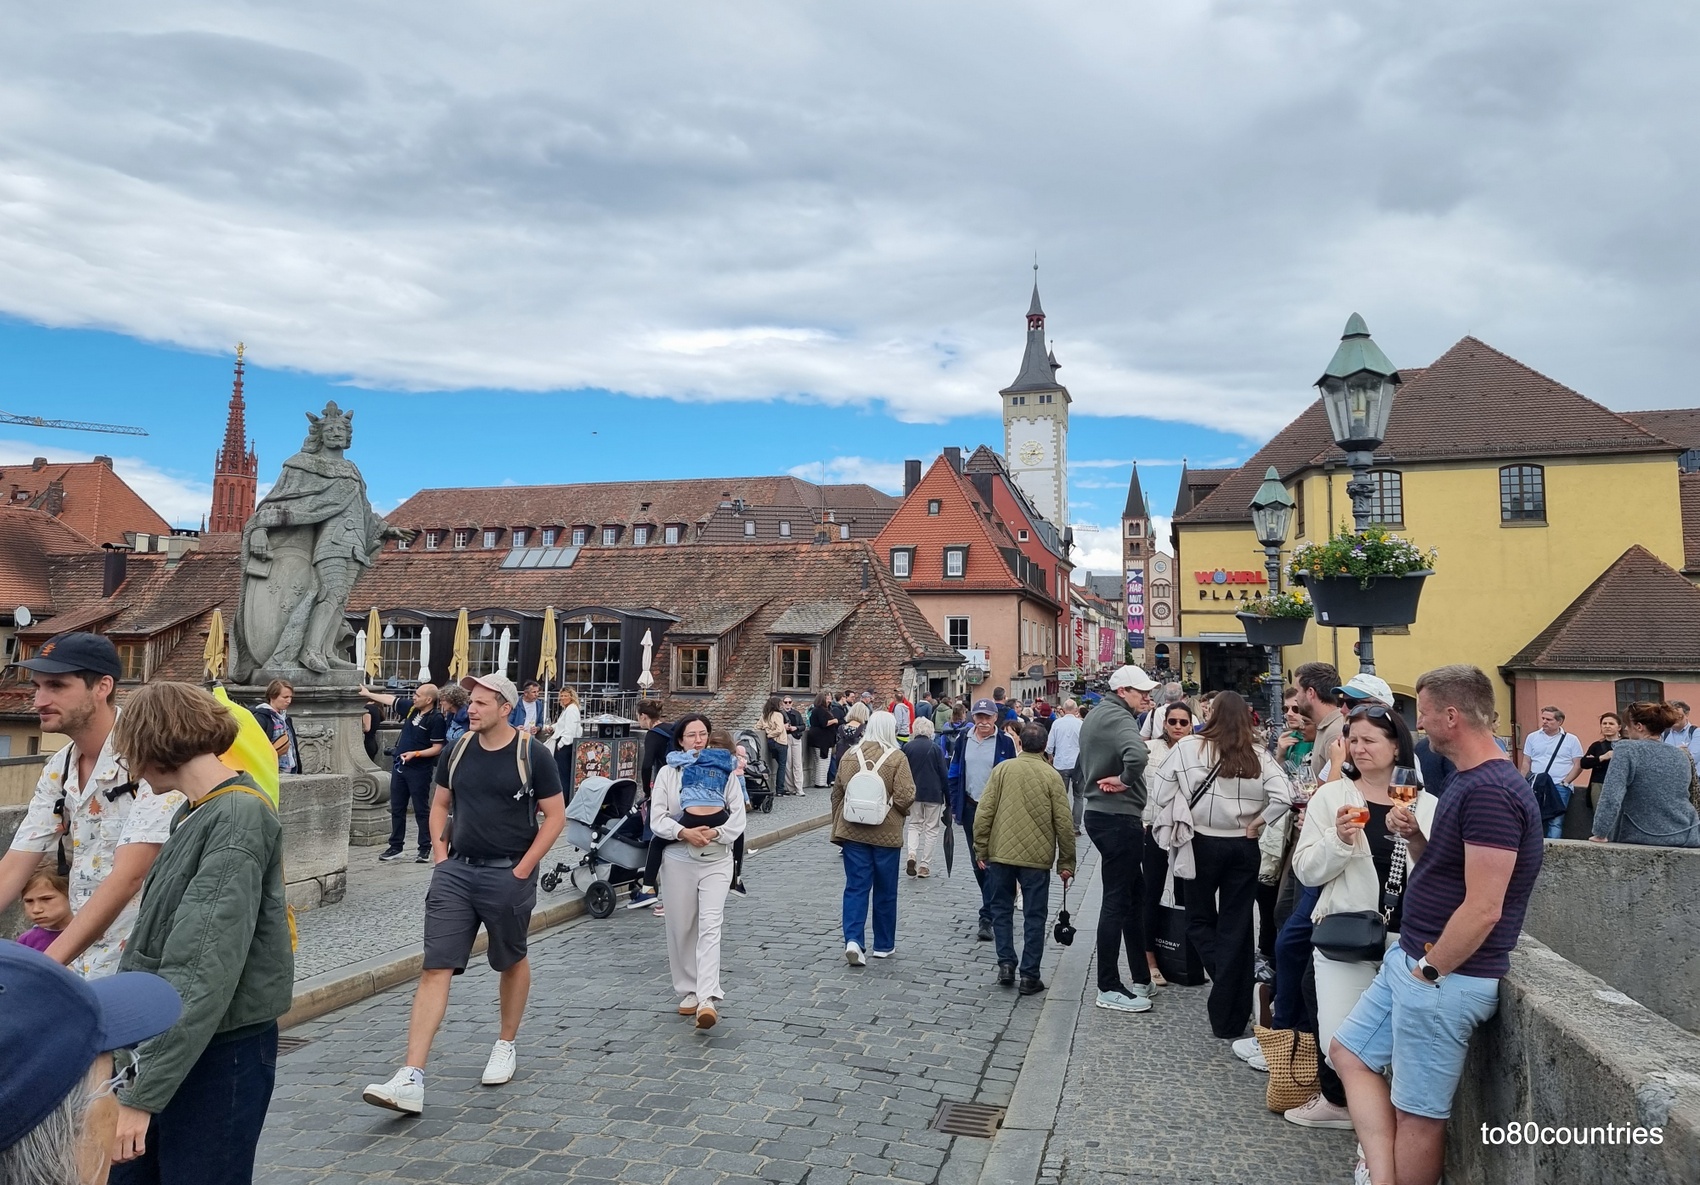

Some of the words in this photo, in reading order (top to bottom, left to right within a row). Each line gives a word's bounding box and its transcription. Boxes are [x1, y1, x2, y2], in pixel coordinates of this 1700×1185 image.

[1194, 568, 1267, 584] WÖHRL
[1199, 590, 1262, 600] PLAZA
[1074, 617, 1083, 640] Markt
[1075, 645, 1083, 671] Media
